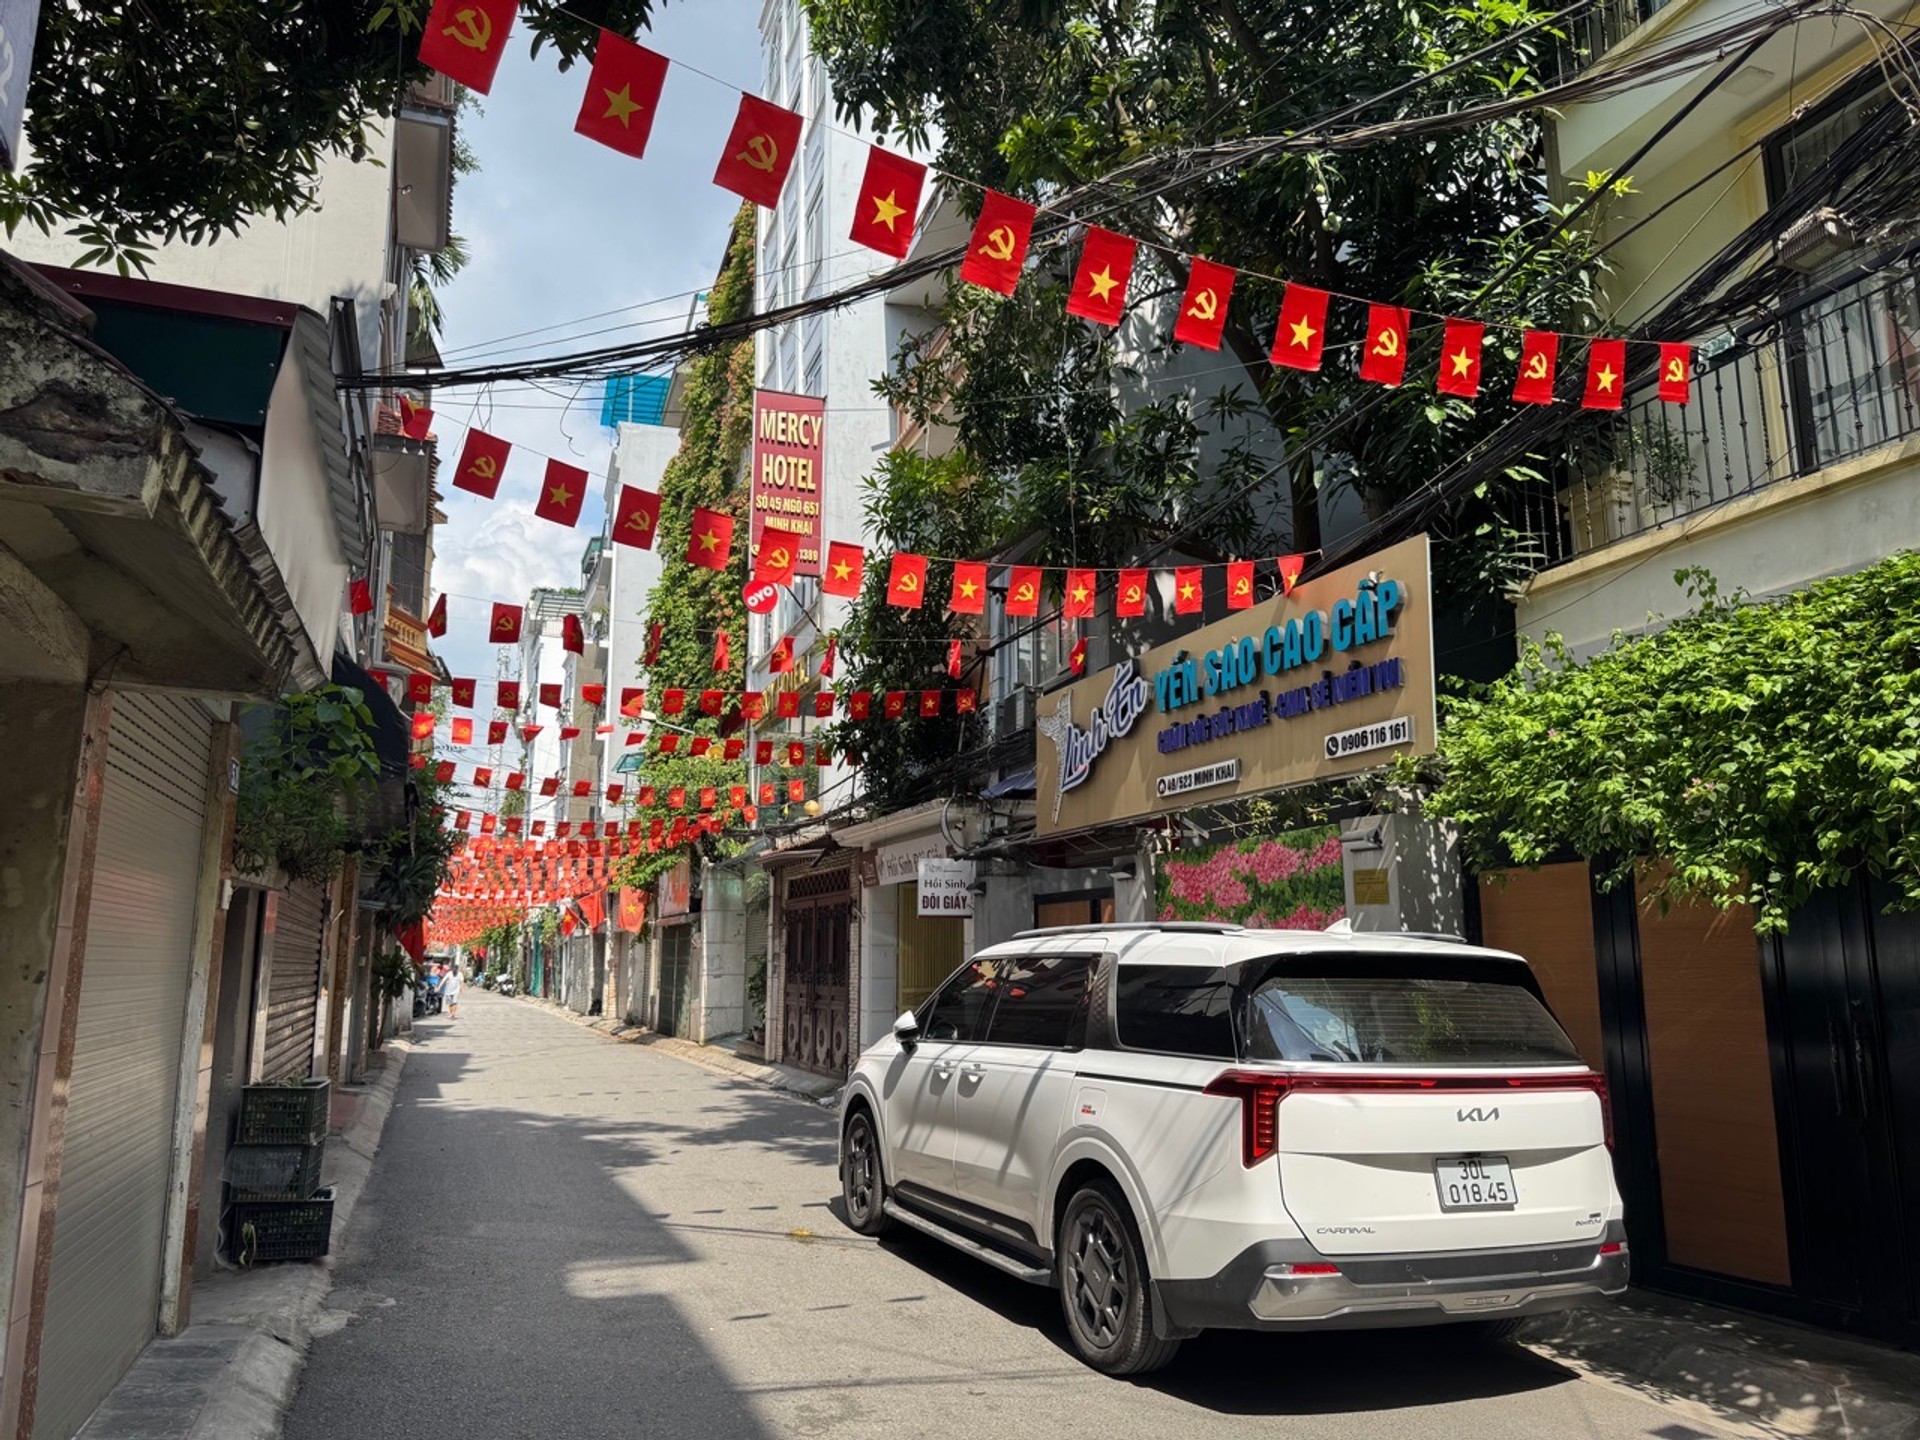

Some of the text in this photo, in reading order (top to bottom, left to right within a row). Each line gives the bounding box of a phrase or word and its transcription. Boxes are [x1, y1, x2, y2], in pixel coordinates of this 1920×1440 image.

[759, 408, 822, 446] MERCY
[761, 453, 816, 491] HOTEL
[769, 497, 782, 511] 45
[802, 500, 819, 515] 651
[764, 516, 813, 535] MINH KHAI
[747, 585, 774, 607] OYO
[1153, 651, 1199, 713] YẾN
[1262, 609, 1325, 676] CAO
[1331, 577, 1401, 653] CẤP
[1341, 721, 1407, 753] 0906 116 161
[1061, 708, 1108, 792] Linh
[1193, 767, 1215, 786] MINH
[1215, 762, 1235, 781] KHAI
[944, 878, 967, 890] Sinh
[922, 892, 940, 910] ĐÔI
[1456, 1107, 1500, 1122] KIA
[1457, 1159, 1491, 1181] 30L
[1448, 1182, 1509, 1204] 018.45
[1316, 1226, 1377, 1235] CARNIVAL
